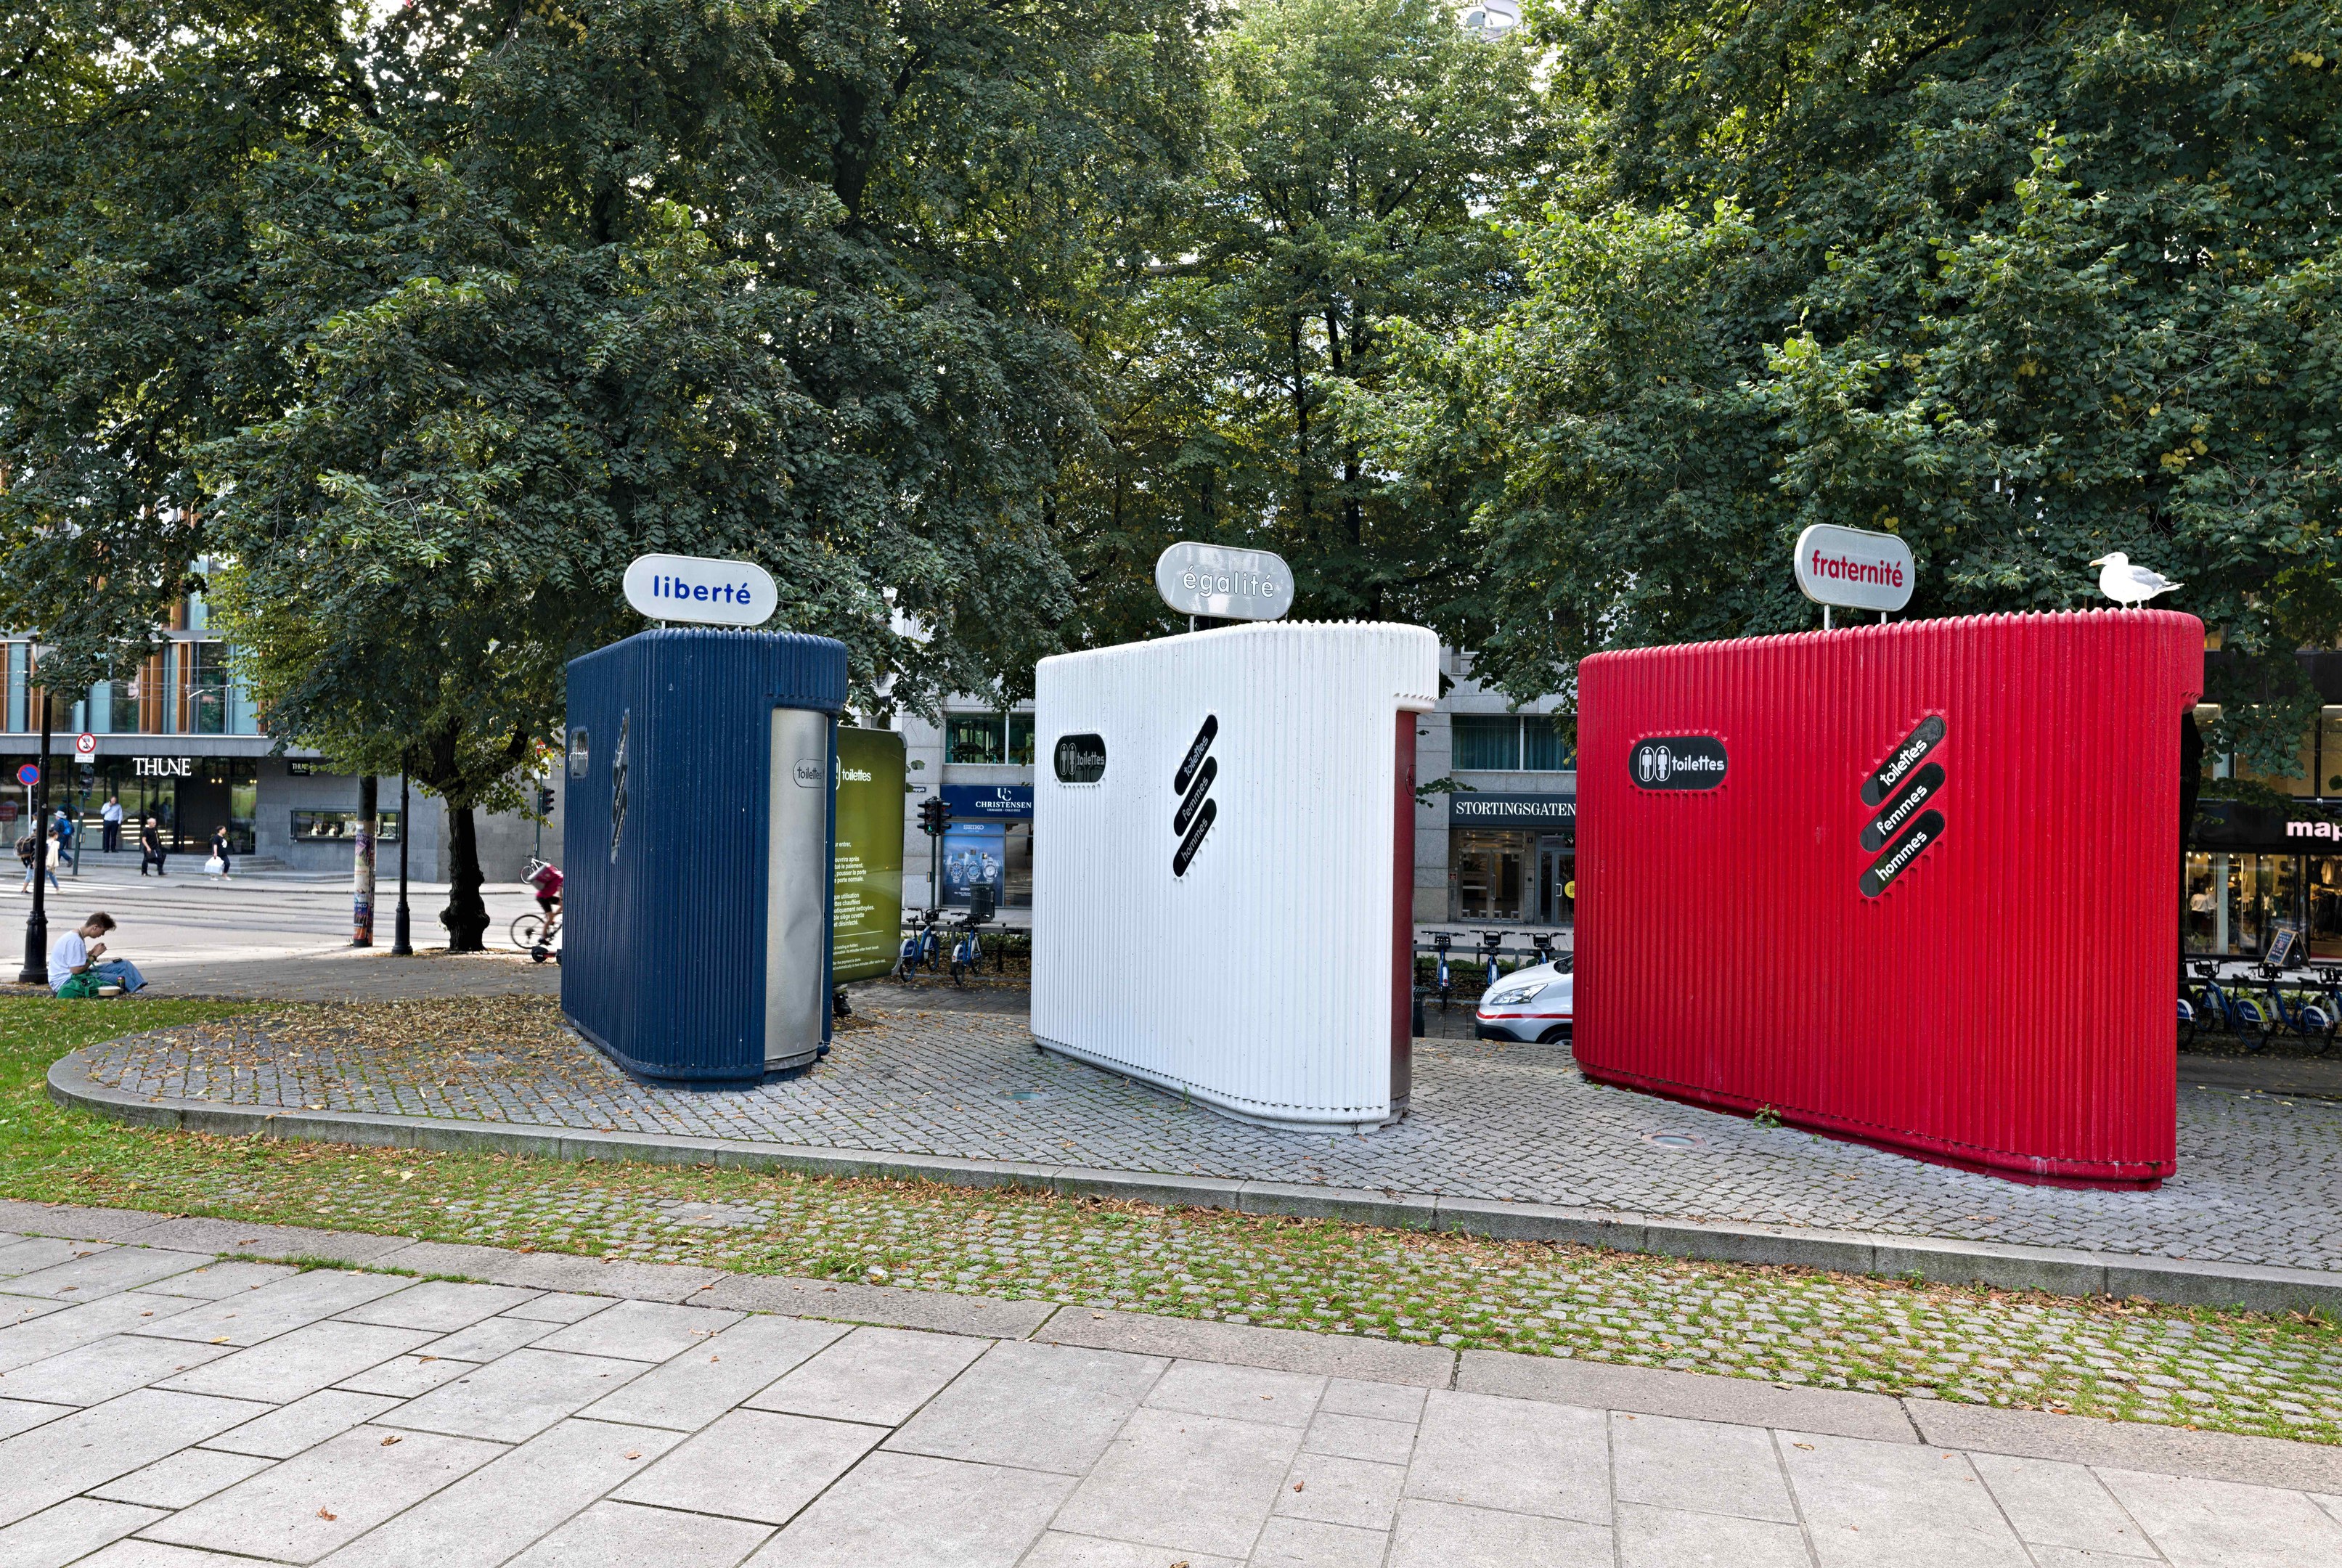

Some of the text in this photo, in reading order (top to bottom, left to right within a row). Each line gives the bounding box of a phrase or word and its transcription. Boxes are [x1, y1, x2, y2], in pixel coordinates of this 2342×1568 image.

[1183, 565, 1274, 597] égalité
[1812, 550, 1903, 587] fraternité
[654, 575, 751, 605] liberté
[132, 757, 192, 776] THUNE
[1077, 751, 1105, 765] toilettes
[1184, 736, 1209, 777] toilettes
[1672, 754, 1725, 771] toilettes
[1880, 740, 1927, 786] toilettes
[797, 767, 822, 780] toilettes
[842, 768, 871, 782] toilettes
[1182, 776, 1209, 821] femmes
[1456, 801, 1576, 816] STORTINGSGATEN
[1877, 785, 1927, 836] femmes
[1181, 818, 1208, 862] hommes
[1875, 831, 1927, 881] hommes
